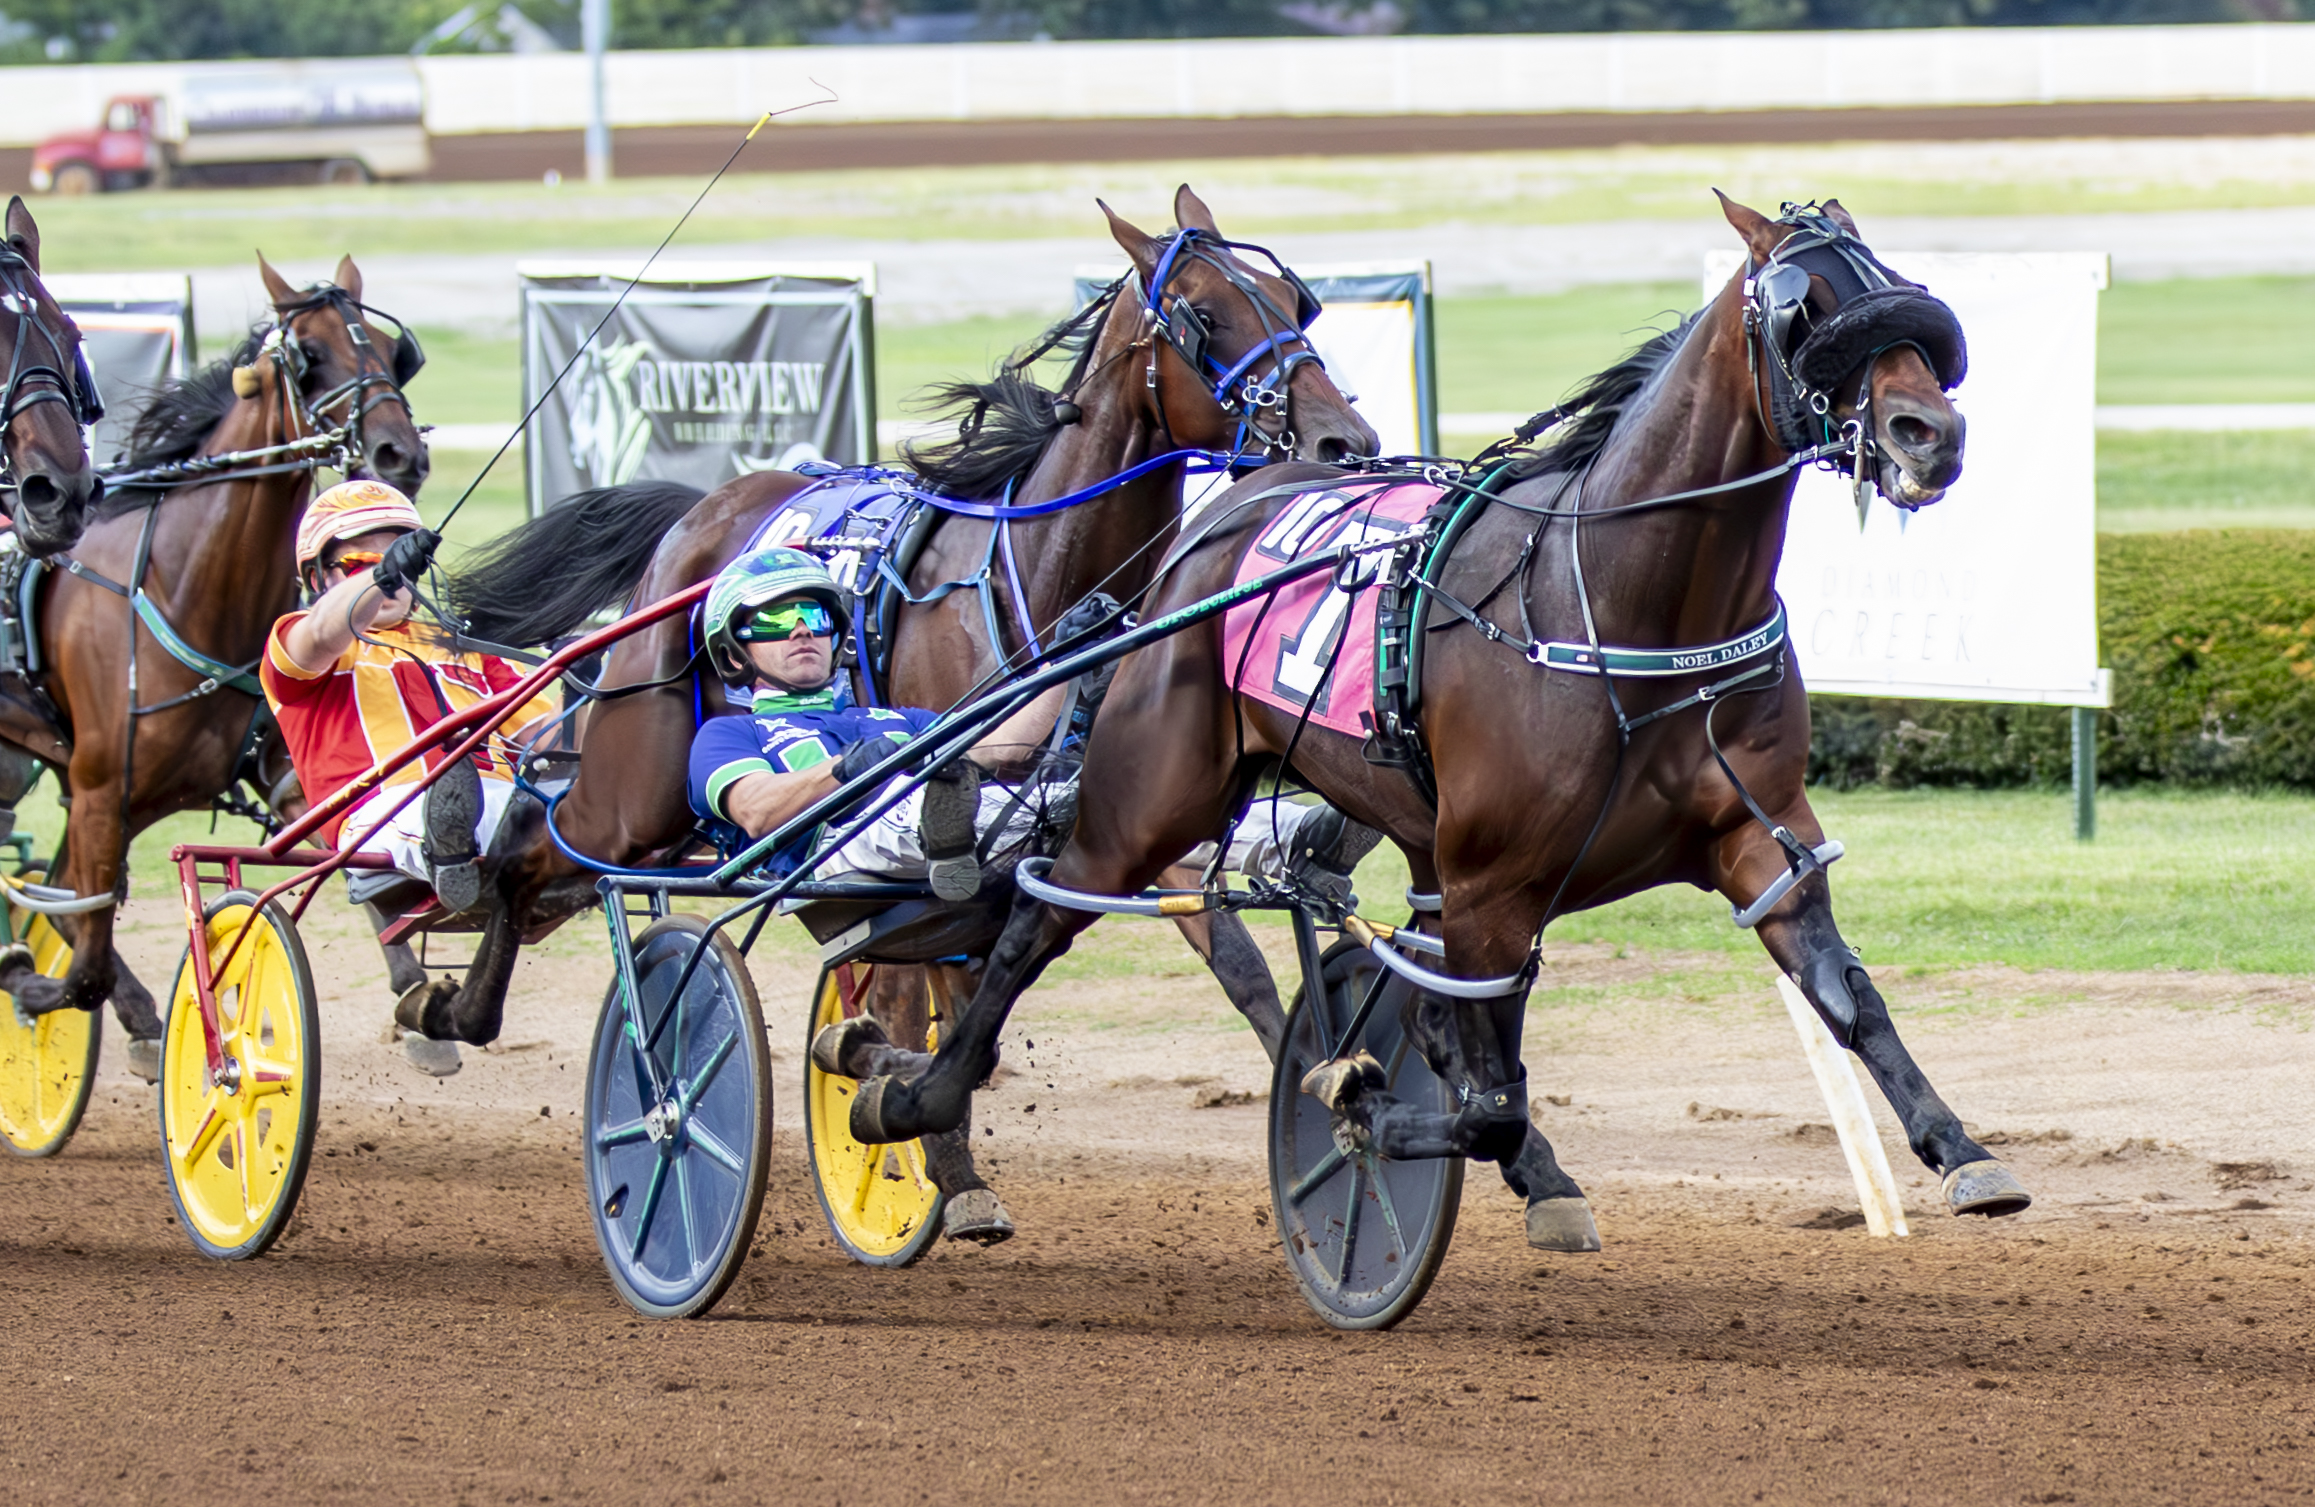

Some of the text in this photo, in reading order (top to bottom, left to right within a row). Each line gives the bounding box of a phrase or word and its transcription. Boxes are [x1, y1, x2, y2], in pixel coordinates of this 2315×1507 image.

[637, 360, 826, 415] RIVERVIEW
[1819, 562, 1977, 603] DIAMOND
[1672, 631, 1769, 670] NOEL DALEY
[1811, 608, 1974, 663] CREEK
